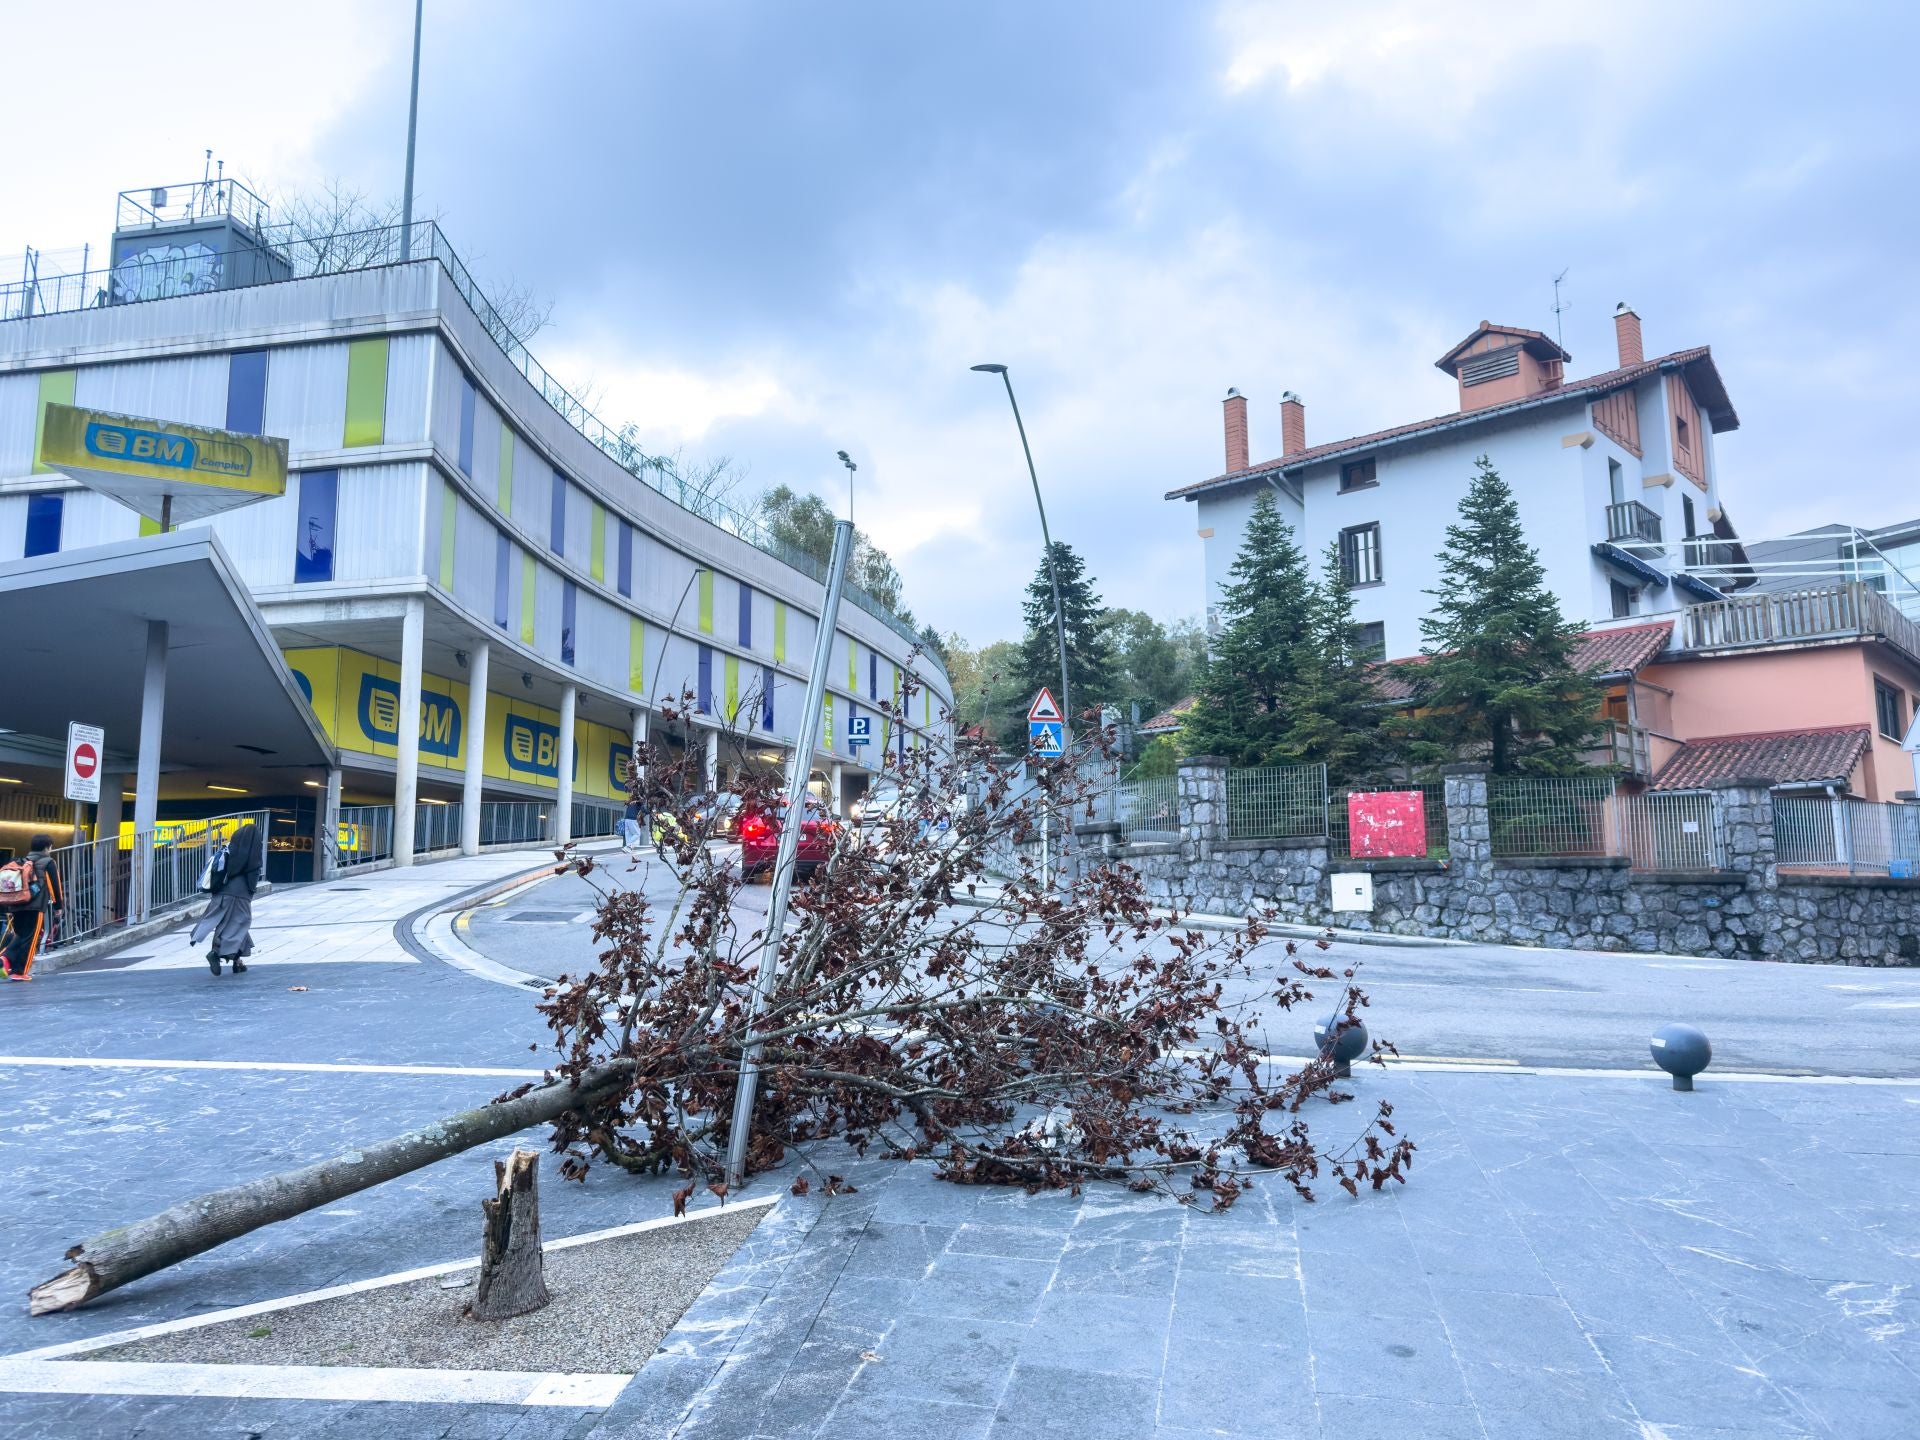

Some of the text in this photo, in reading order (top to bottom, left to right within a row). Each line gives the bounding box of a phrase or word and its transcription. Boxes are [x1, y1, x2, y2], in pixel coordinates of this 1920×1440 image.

[131, 435, 185, 463] BM
[853, 718, 866, 734] P
[537, 731, 560, 769] B
